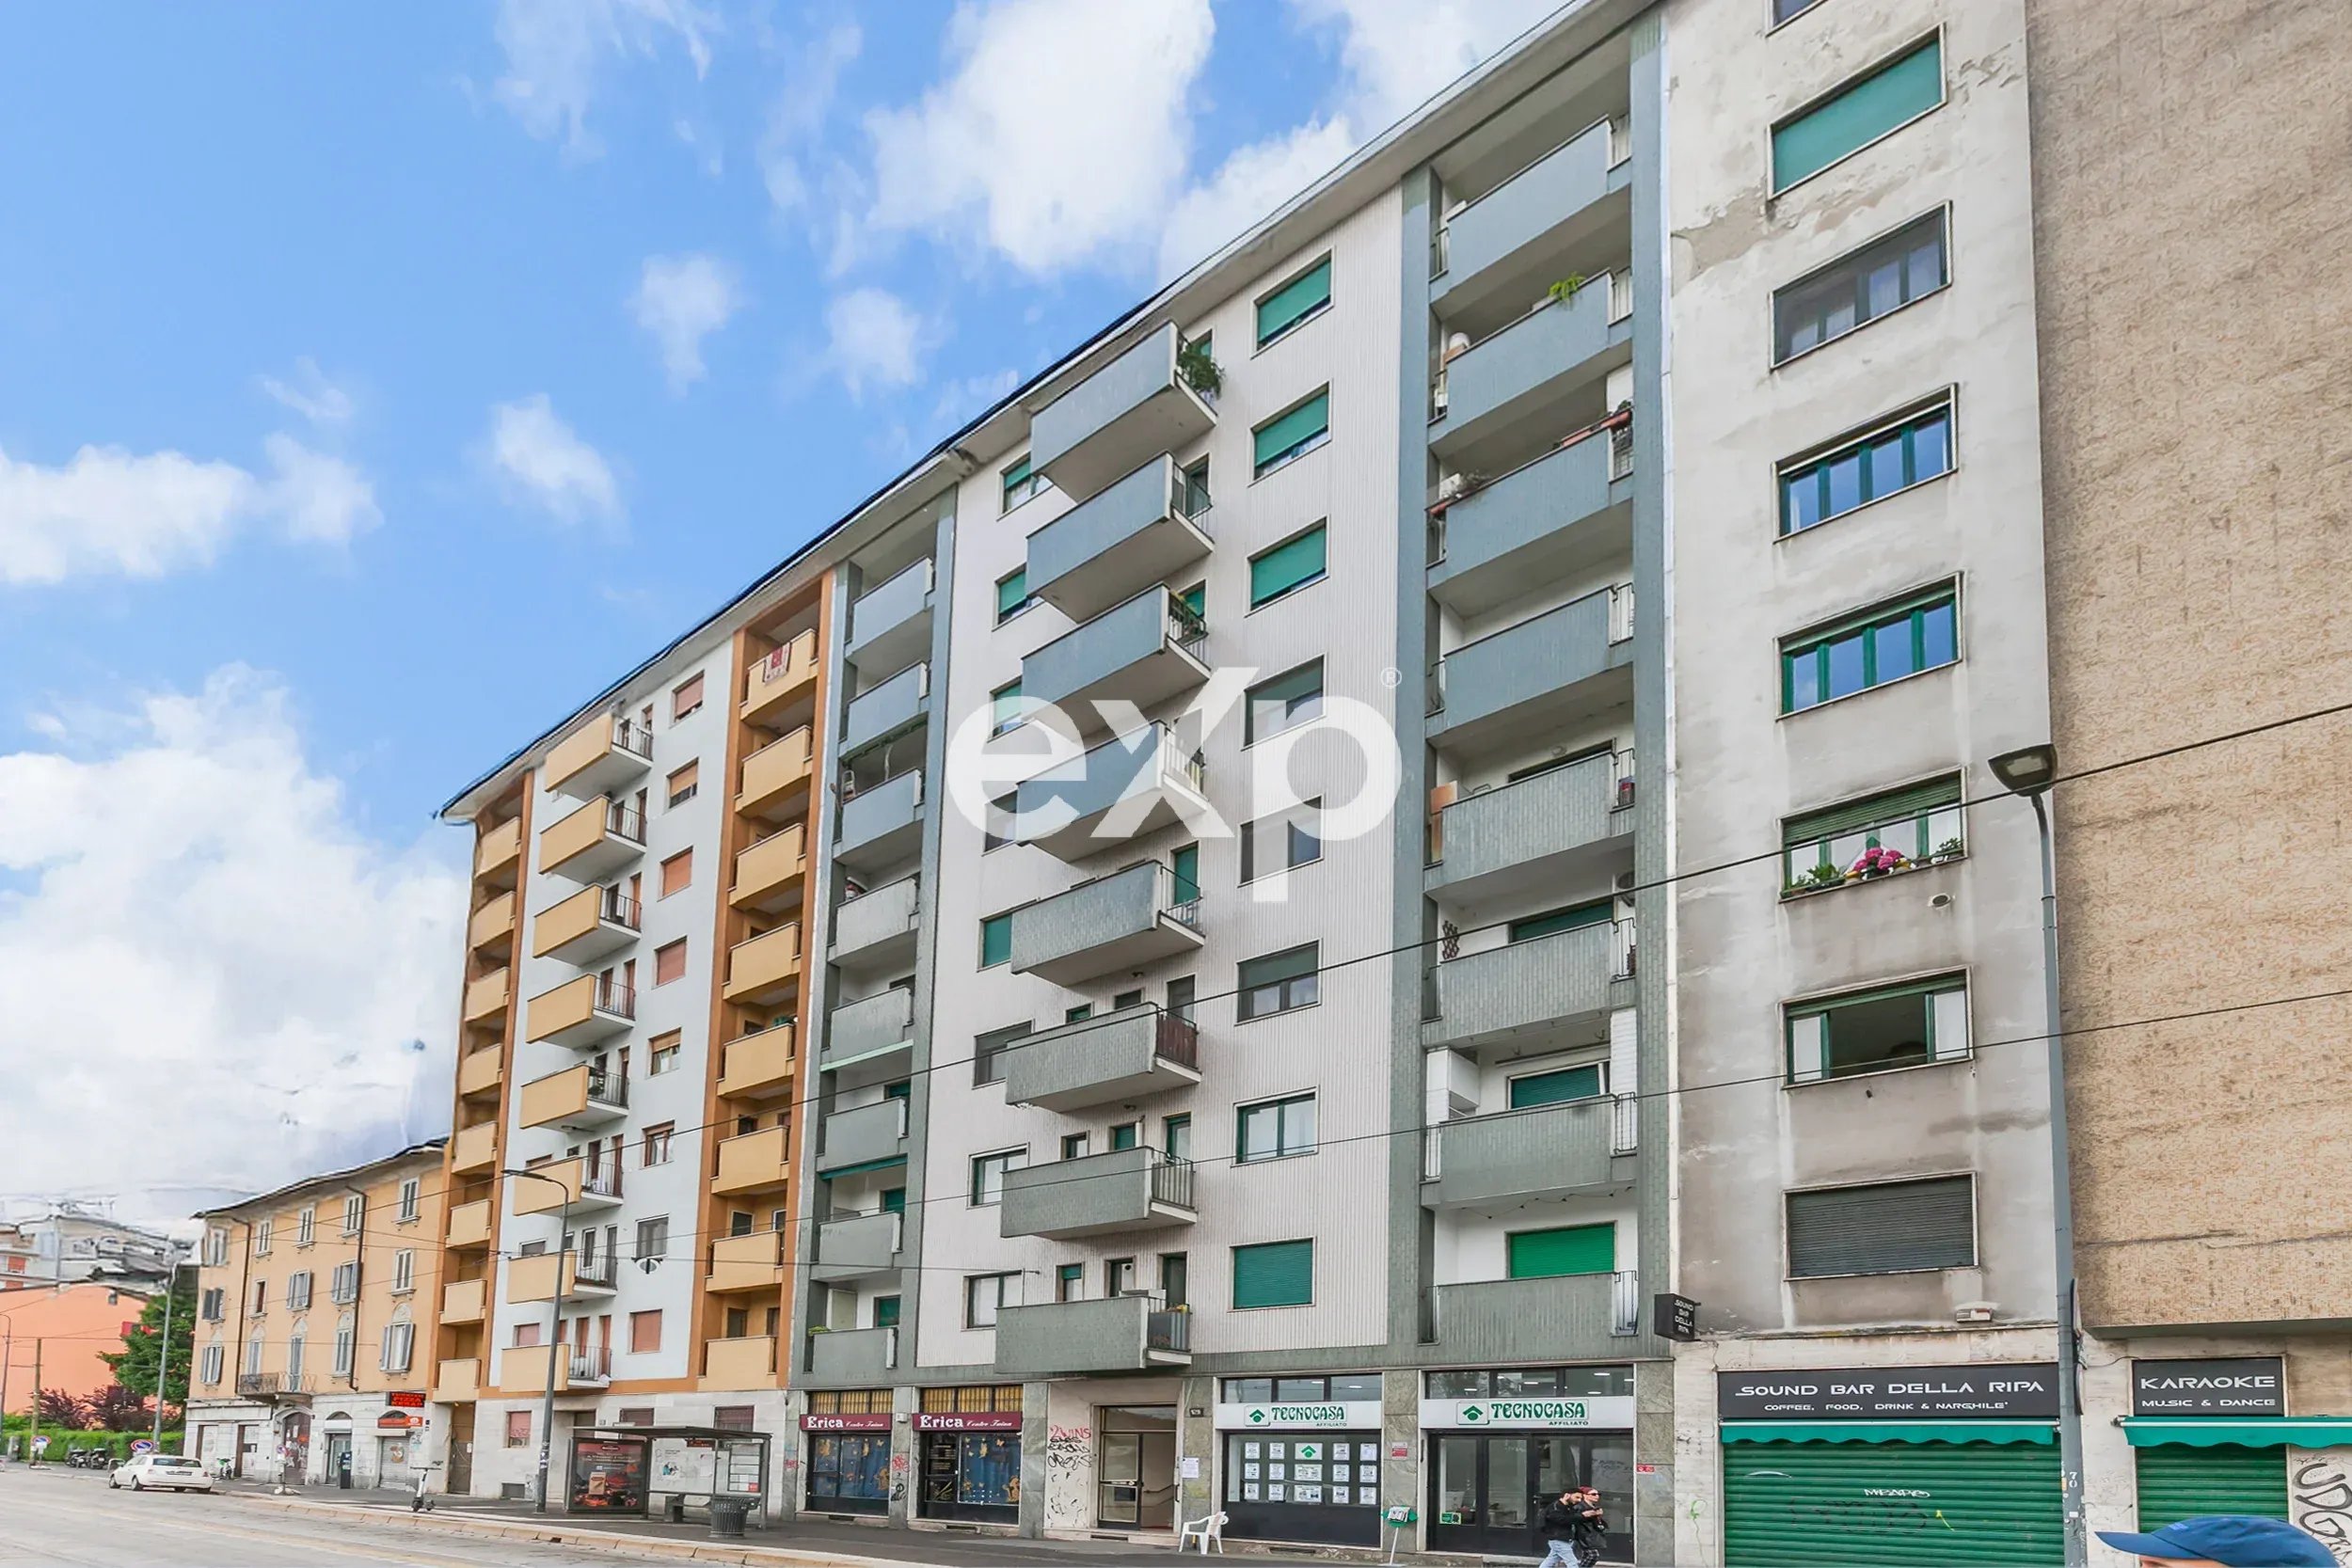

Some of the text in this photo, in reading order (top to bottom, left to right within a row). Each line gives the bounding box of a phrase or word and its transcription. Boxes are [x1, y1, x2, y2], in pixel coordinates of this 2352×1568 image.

[1674, 1299, 1694, 1311] SOUND
[1735, 1381, 2044, 1396] SOUND BAR DELLA RIPA
[2140, 1376, 2275, 1389] KARAOKE
[2141, 1399, 2193, 1407] MUSIC
[2201, 1399, 2212, 1407] &
[1271, 1406, 1345, 1421] TECNOCASA
[1491, 1402, 1586, 1418] TECNOCASA
[806, 1416, 844, 1429] Erica
[919, 1415, 963, 1428] Erica
